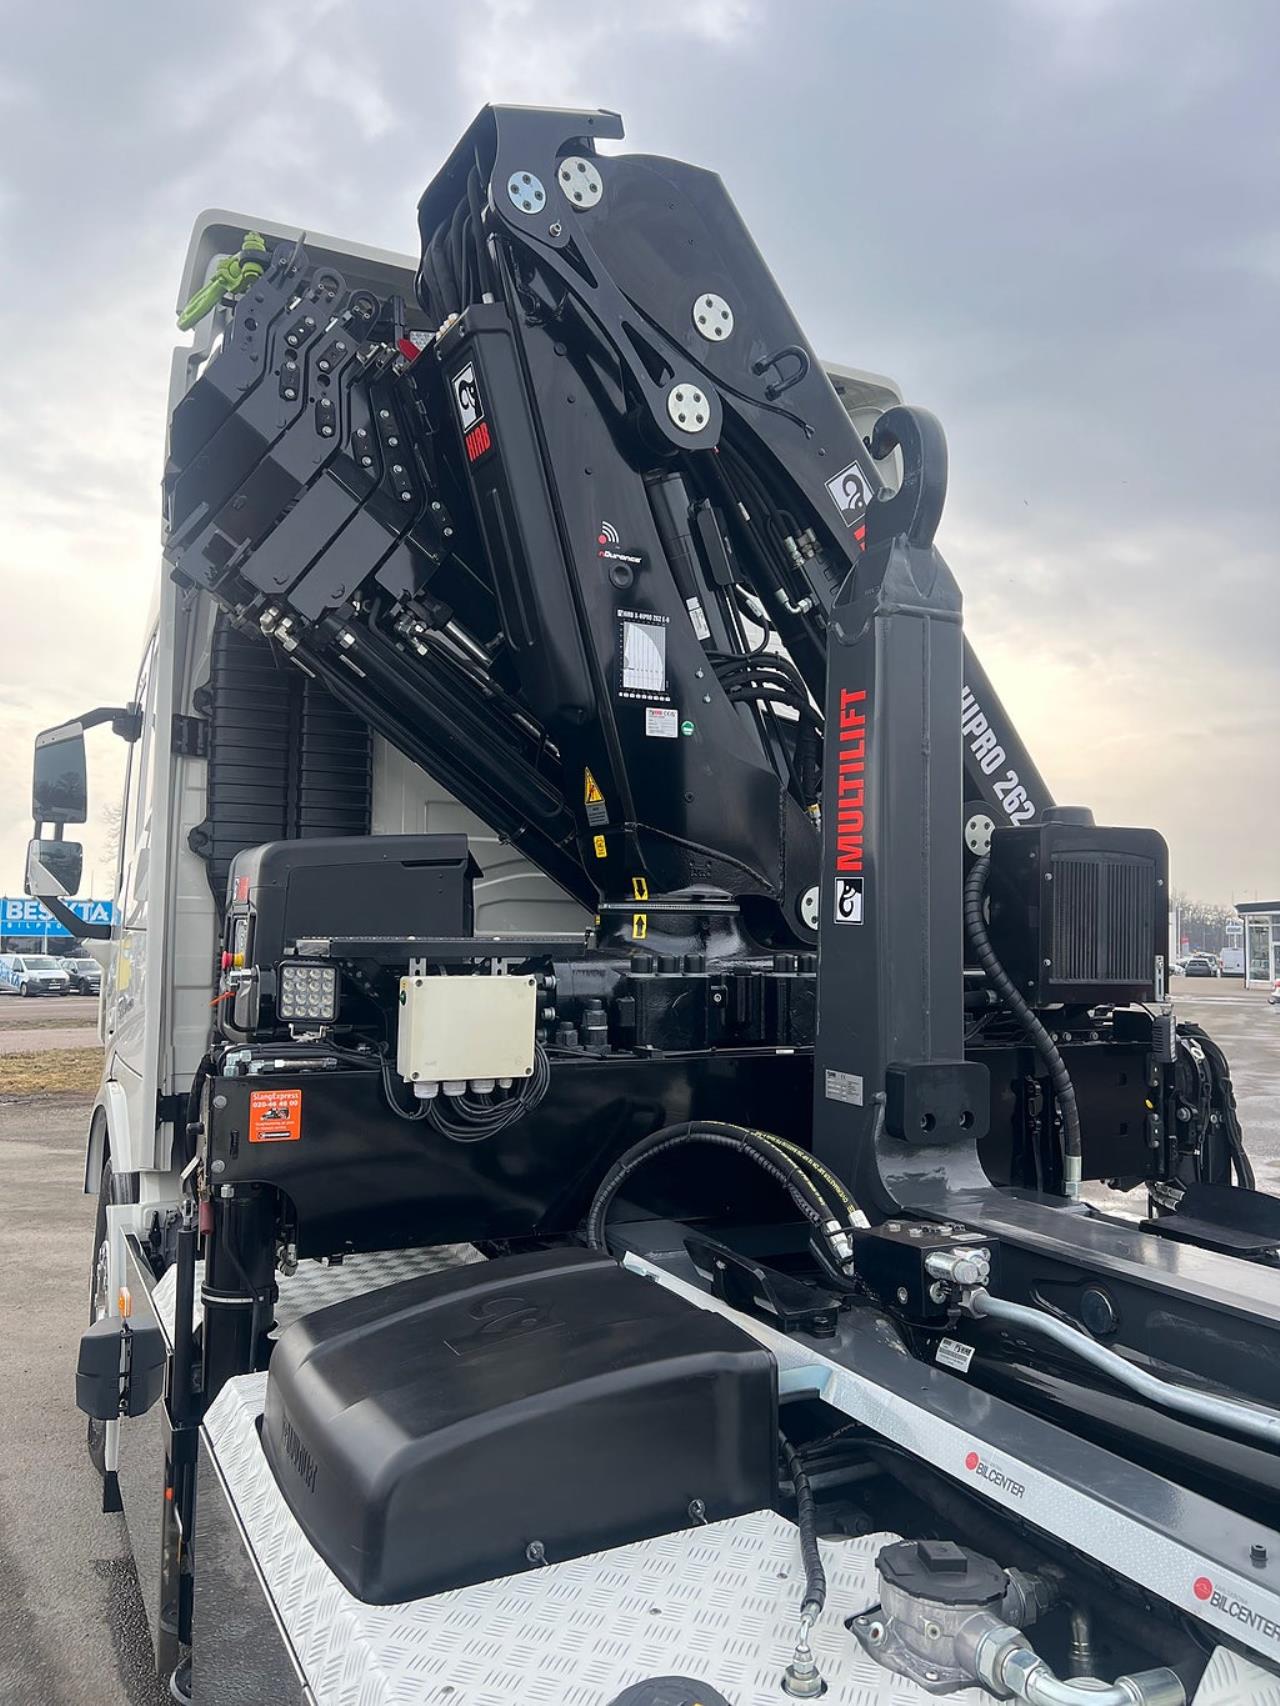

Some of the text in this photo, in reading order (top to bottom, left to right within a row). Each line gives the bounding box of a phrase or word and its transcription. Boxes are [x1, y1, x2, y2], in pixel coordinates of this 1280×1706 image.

[465, 422, 491, 462] HIAB
[836, 688, 867, 871] MULTILIFT
[992, 770, 1036, 827] 262
[6, 900, 110, 921] BESTA
[976, 1462, 1026, 1498] BILCENTER
[1210, 1591, 1280, 1642] BILCENTER
